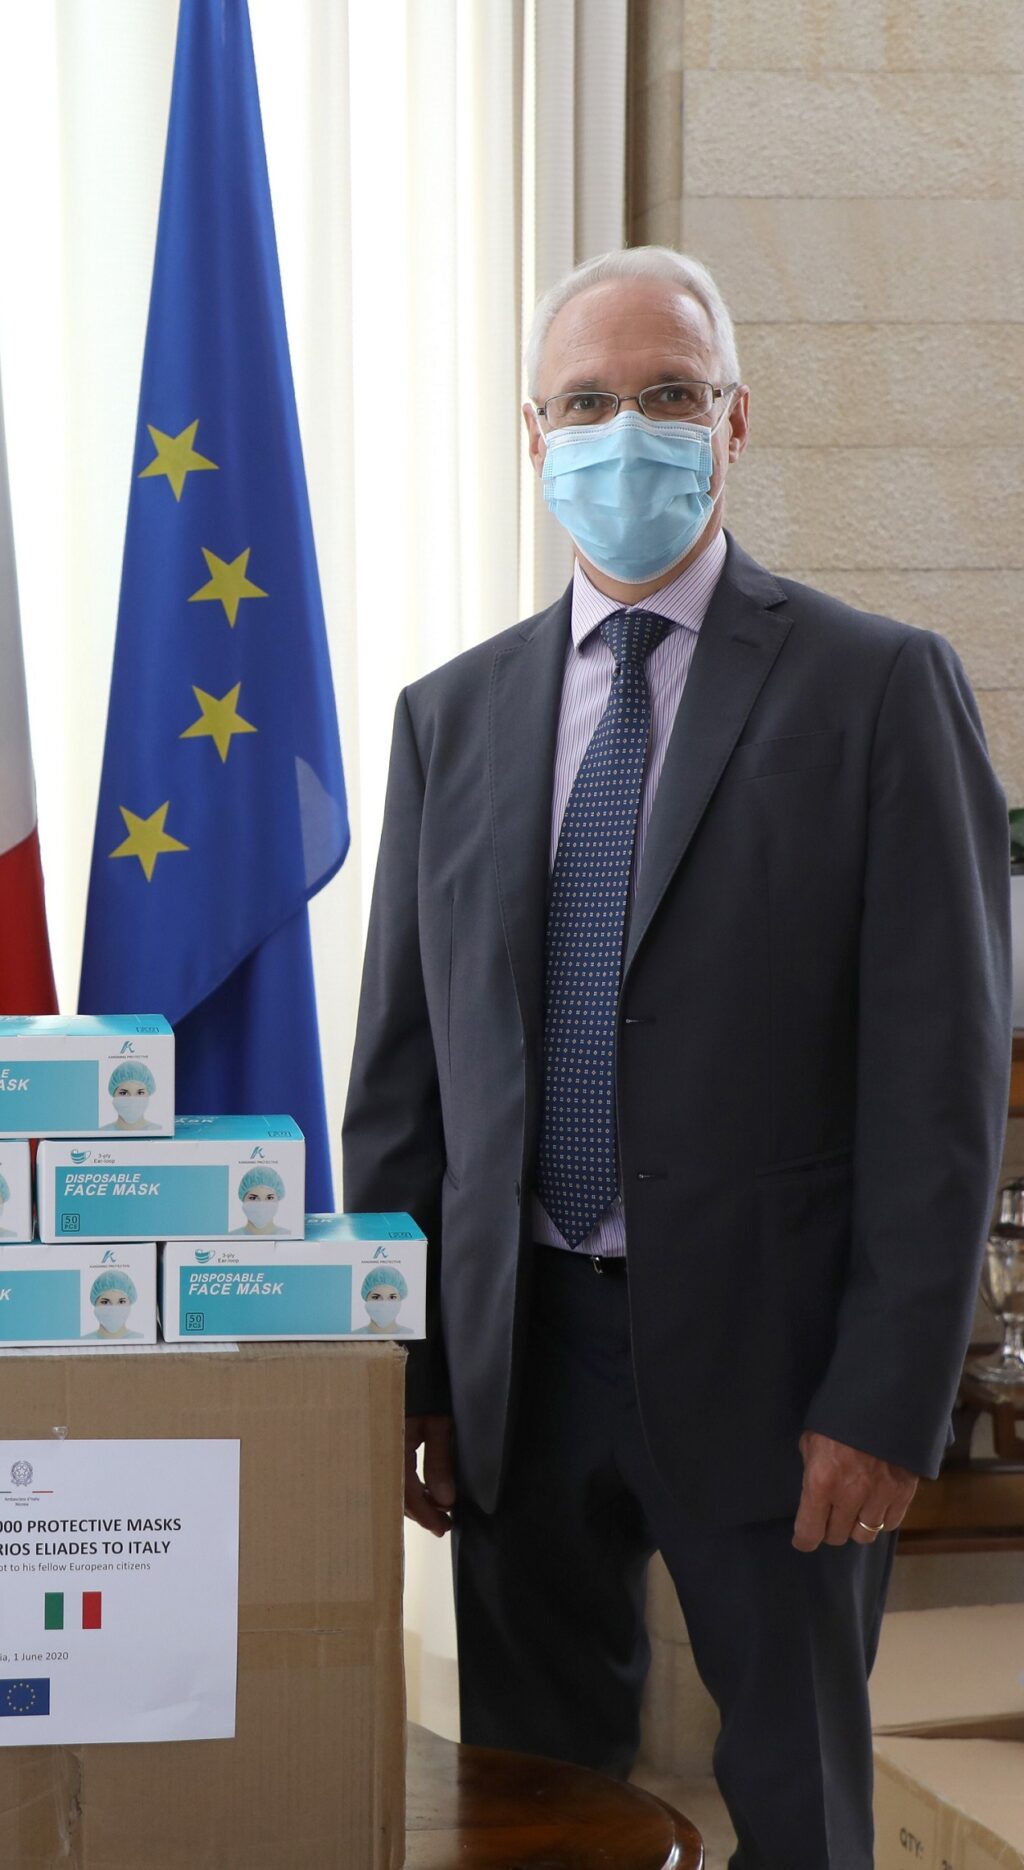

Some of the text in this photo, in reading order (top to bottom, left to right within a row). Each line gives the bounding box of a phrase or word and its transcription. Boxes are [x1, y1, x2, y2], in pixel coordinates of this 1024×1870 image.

[65, 1173, 142, 1184] DISPOSABLE
[64, 1183, 161, 1196] FACE MASK
[65, 1216, 78, 1224] 50
[190, 1273, 264, 1283] DISPOSABLE
[188, 1283, 284, 1295] FACE MASK
[189, 1315, 202, 1323] 50
[27, 1519, 122, 1533] PROTECTIVE
[126, 1518, 182, 1532] MASKS
[35, 1542, 97, 1556] ELIADES
[101, 1541, 124, 1555] TO
[128, 1540, 172, 1554] ITALY
[10, 1564, 20, 1573] to
[22, 1562, 36, 1572] his
[38, 1562, 68, 1572] fellow
[69, 1562, 114, 1574] European
[116, 1561, 151, 1571] citizens
[14, 1653, 19, 1661] 1
[21, 1652, 43, 1661] June
[45, 1652, 69, 1660] 2020
